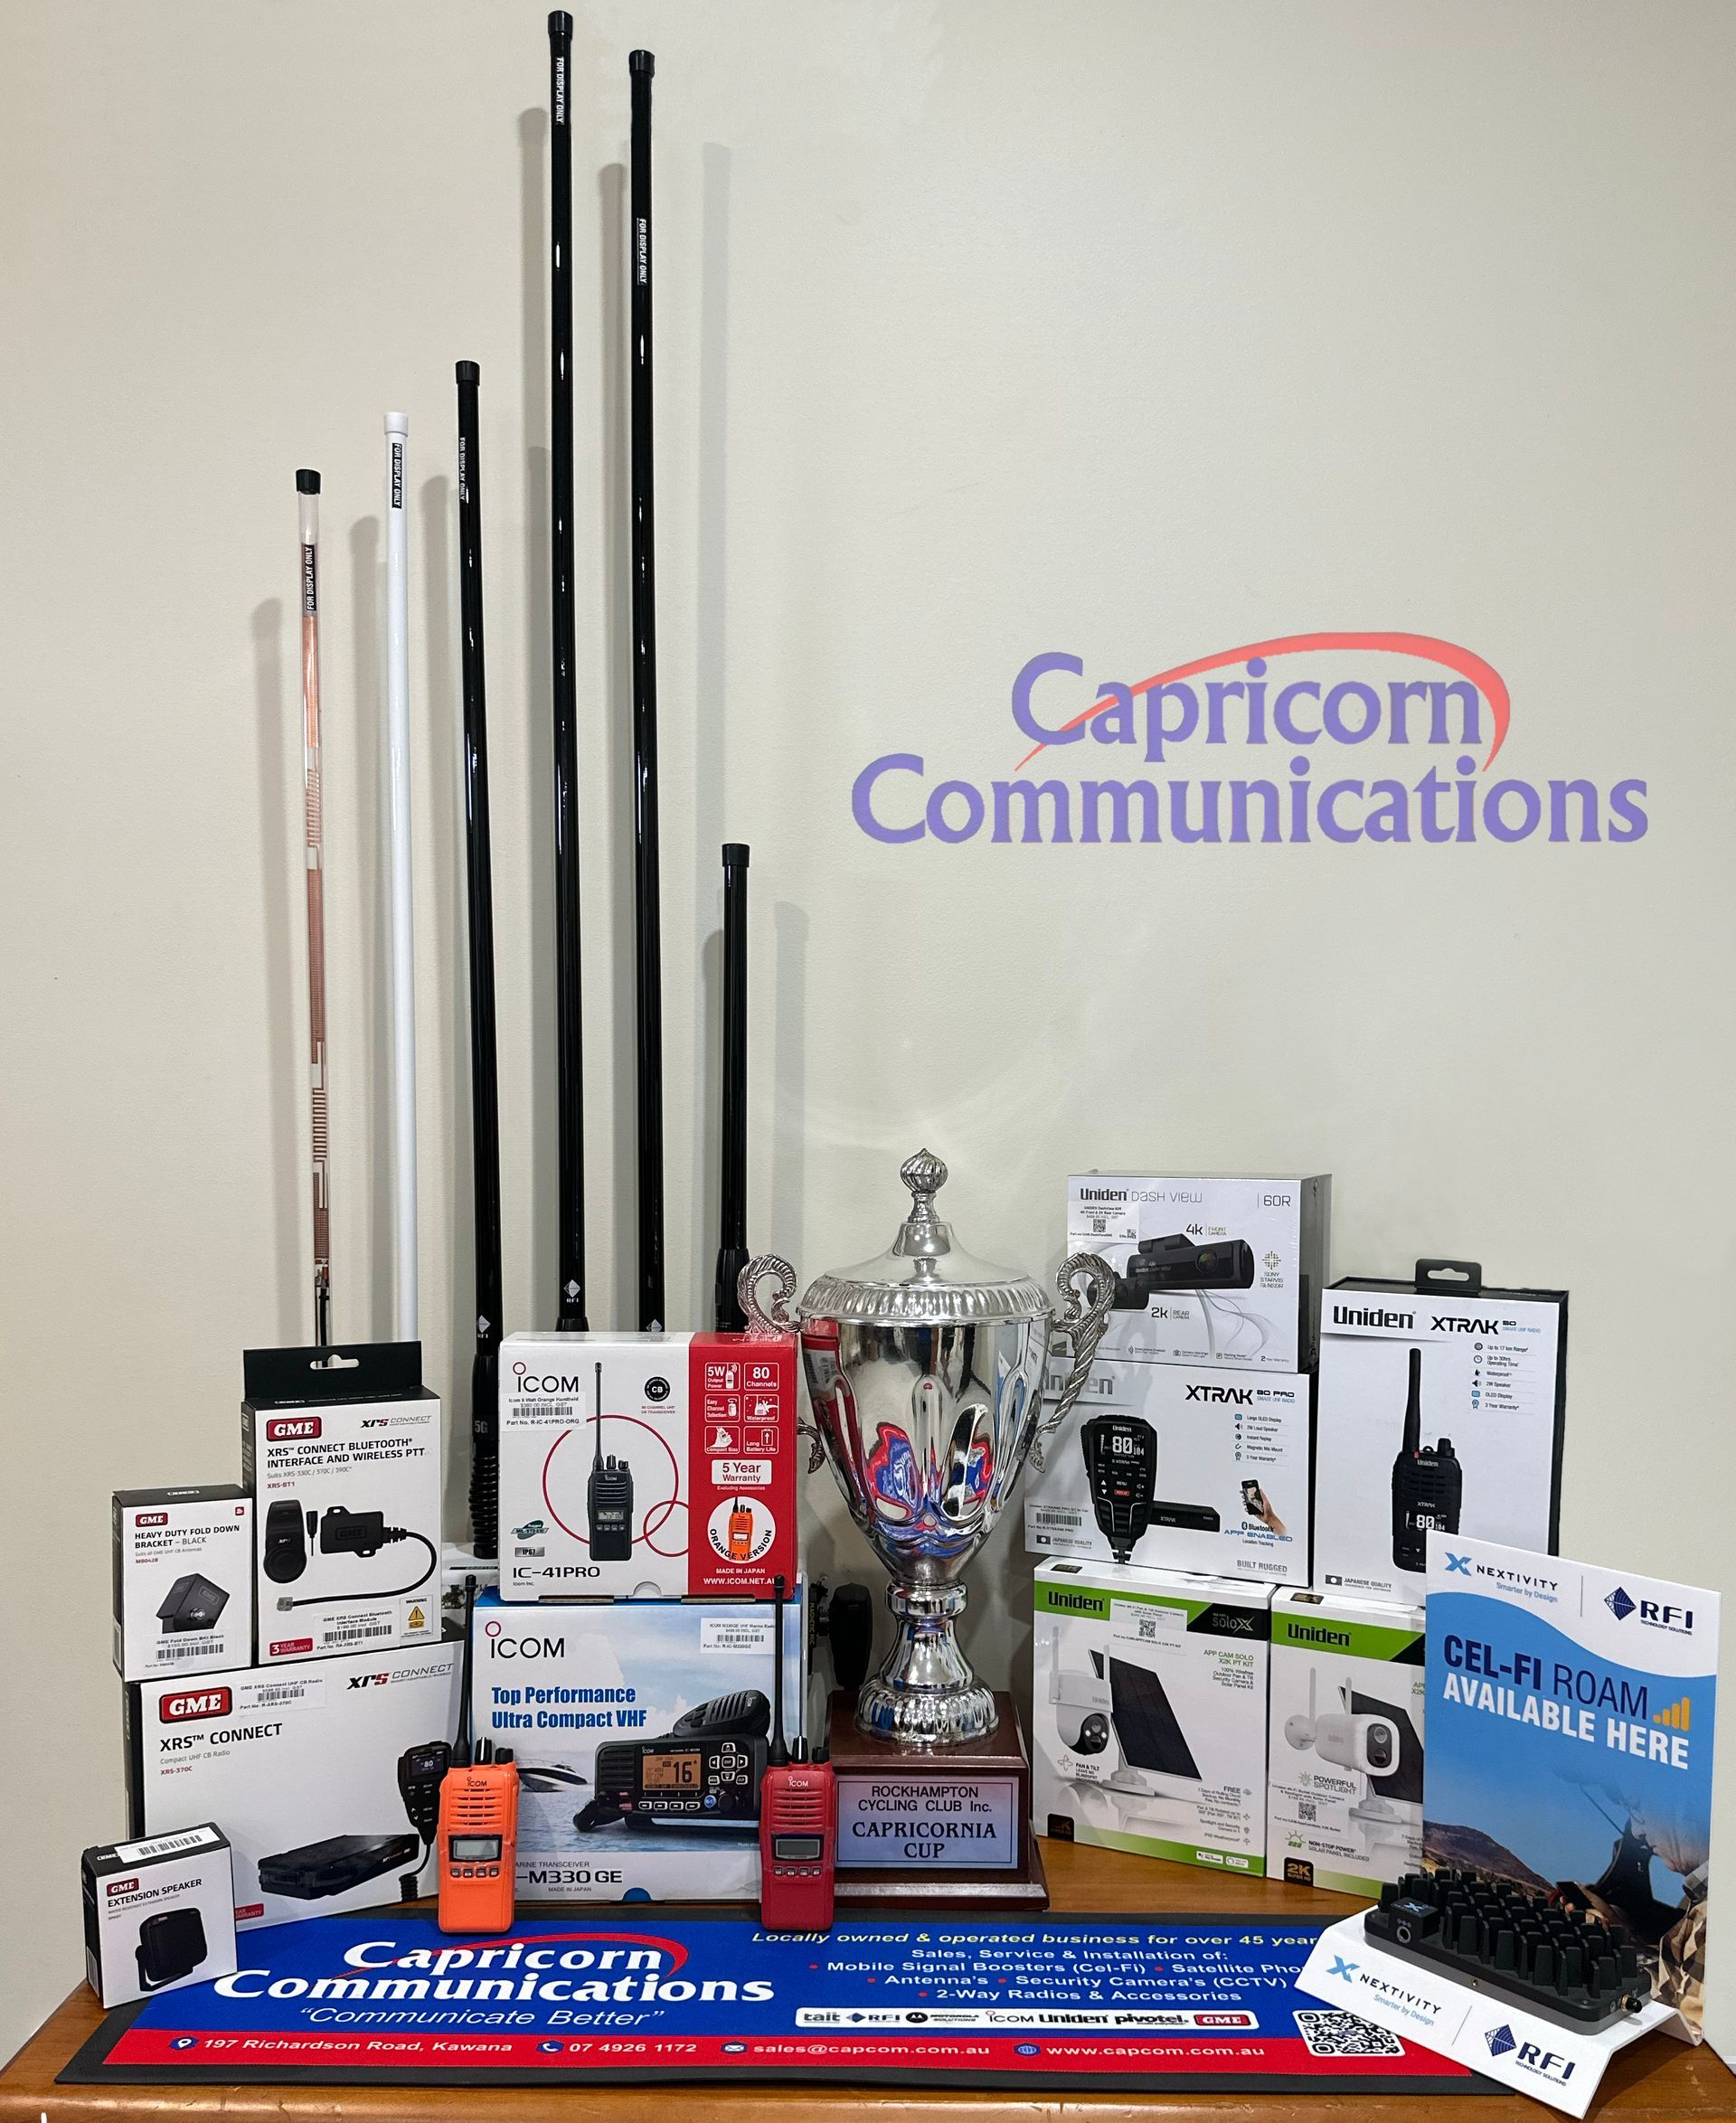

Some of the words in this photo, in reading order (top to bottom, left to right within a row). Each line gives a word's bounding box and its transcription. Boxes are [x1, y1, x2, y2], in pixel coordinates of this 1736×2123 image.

[556, 57, 564, 72] FOR
[556, 73, 564, 104] DISPLAY
[556, 104, 564, 123] ONLY
[639, 218, 647, 233] FOR
[639, 234, 647, 264] DISPLAY
[639, 265, 647, 284] ONLY
[305, 546, 313, 565] ONLY
[306, 566, 315, 595] DISPLAY
[307, 596, 315, 610] FOR
[1080, 1188, 1127, 1201] Uniden
[1263, 1194, 1291, 1207] 60R
[1333, 1305, 1414, 1329] Uniden
[1430, 1316, 1499, 1335] XTRAK
[707, 1366, 725, 1376] 5W
[752, 1367, 770, 1379] 80
[1184, 1384, 1253, 1404] XTRAK
[274, 1421, 314, 1437] GME
[297, 1443, 345, 1455] CONNECT
[1112, 1436, 1132, 1454] 80
[267, 1455, 324, 1468] INTERFACE
[326, 1453, 350, 1463] AND
[353, 1449, 402, 1461] WIRELESS
[406, 1448, 425, 1457] PTT
[722, 1462, 730, 1473] 5
[732, 1462, 761, 1473] Year
[722, 1475, 761, 1483] Warranty
[139, 1515, 164, 1524] GME
[135, 1531, 163, 1539] HEAVY
[165, 1529, 187, 1537] DUTY
[190, 1527, 212, 1535] FOLD
[213, 1524, 240, 1533] DOWN
[135, 1540, 173, 1549] BRACKET
[182, 1536, 207, 1544] BLACK
[710, 1528, 738, 1561] ORANGE
[740, 1530, 772, 1561] VERSION
[513, 1566, 600, 1578] IC-41PRO
[1237, 1560, 1257, 1569] BUILT
[1259, 1562, 1288, 1572] RUGGED
[1048, 1590, 1104, 1611] Uniden
[1477, 1564, 1558, 1591] NEXTIVITY
[1640, 1599, 1694, 1628] RFI
[1496, 1582, 1524, 1595] Smarter
[1525, 1588, 1533, 1599] by
[1533, 1590, 1558, 1603] Design
[1288, 1623, 1350, 1647] Uniden
[1640, 1619, 1668, 1631] TECHNOLOGY
[1668, 1625, 1693, 1636] SOLUTIONS
[1218, 1651, 1235, 1659] CAM
[1235, 1653, 1254, 1661] SOLO
[1444, 1634, 1542, 1691] CEL-FI
[1553, 1663, 1648, 1721] ROAM
[492, 1687, 521, 1705] Top
[524, 1686, 636, 1703] Performance
[168, 1694, 222, 1717] GME
[492, 1711, 533, 1728] Ultra
[536, 1710, 613, 1729] Compact
[616, 1710, 646, 1727] VHF
[1442, 1672, 1596, 1743] AVAILABLE
[1607, 1717, 1689, 1770] HERE
[210, 1722, 283, 1745] CONNECT
[160, 1755, 187, 1765] Compact
[188, 1752, 203, 1761] UHF
[212, 1749, 231, 1758] Radio
[160, 1766, 193, 1776] XRS-370C
[673, 1761, 693, 1783] 16
[1314, 1775, 1356, 1788] POWERFUL
[1314, 1781, 1357, 1795] SPOTLIGHT
[872, 1786, 978, 1798] ROCKHAMPTON
[858, 1799, 918, 1812] CYCLING
[926, 1800, 962, 1812] CLUB
[970, 1802, 993, 1812] Inc.
[853, 1822, 996, 1838] CAPRICORNIA
[903, 1843, 945, 1858] CUP
[1308, 1840, 1335, 1848] NON-STOP
[1308, 1845, 1326, 1854] SOLAR
[1343, 1852, 1370, 1863] INCLUDED
[1287, 1863, 1311, 1876] 2K
[108, 1888, 160, 1908] EXTENSION
[161, 1878, 203, 1894] SPEAKER
[110, 1882, 135, 1894] GME
[752, 1933, 830, 1943] Locally
[837, 1933, 909, 1942] owned
[916, 1933, 930, 1943] &
[939, 1933, 1033, 1944] operated
[1043, 1934, 1140, 1944] business
[1147, 1934, 1178, 1944] for
[1184, 1936, 1232, 1945] over
[1240, 1935, 1264, 1945] 45
[1271, 1936, 1316, 1946] year
[344, 1941, 662, 1976] Capricorn
[911, 1949, 972, 1959] Sales,
[979, 1949, 1054, 1959] Service
[1062, 1950, 1076, 1959] &
[1083, 1950, 1195, 1960] Installation
[1202, 1950, 1228, 1960] of:
[827, 1962, 894, 1971] Mobile
[902, 1962, 966, 1973] Signal
[974, 1962, 1065, 1972] Boosters
[1073, 1963, 1146, 1974] (Cel-Fi)
[1172, 1964, 1254, 1973] Satellite
[213, 1969, 775, 2002] Communications
[1015, 1976, 1108, 1987] Security
[1213, 1977, 1288, 1988] (CCTV)
[936, 1989, 1001, 2001] 2-Way
[1008, 1990, 1081, 2000] Radios
[1089, 1991, 1104, 2000] &
[1111, 1991, 1242, 2001] Accessories
[1373, 1993, 1401, 2011] Smarter
[1401, 2004, 1410, 2015] by
[1410, 2009, 1435, 2025] Design
[804, 2011, 841, 2022] tait
[868, 2014, 901, 2022] RFI
[1039, 2014, 1107, 2024] Uniden
[1201, 2015, 1242, 2024] GME
[1359, 1973, 1442, 2014] NEXTIVITY
[1517, 2042, 1576, 2080] RFI
[204, 2040, 238, 2049] 197
[242, 2040, 360, 2051] Richardson
[367, 2041, 424, 2052] Road,
[432, 2042, 512, 2052] Kawana
[569, 2043, 593, 2052] 07
[599, 2043, 646, 2052] 4926
[656, 2043, 697, 2052] 1172
[754, 2044, 990, 2054] sales@capcom.com.au
[1046, 2046, 1266, 2056] www.capcom.com.au
